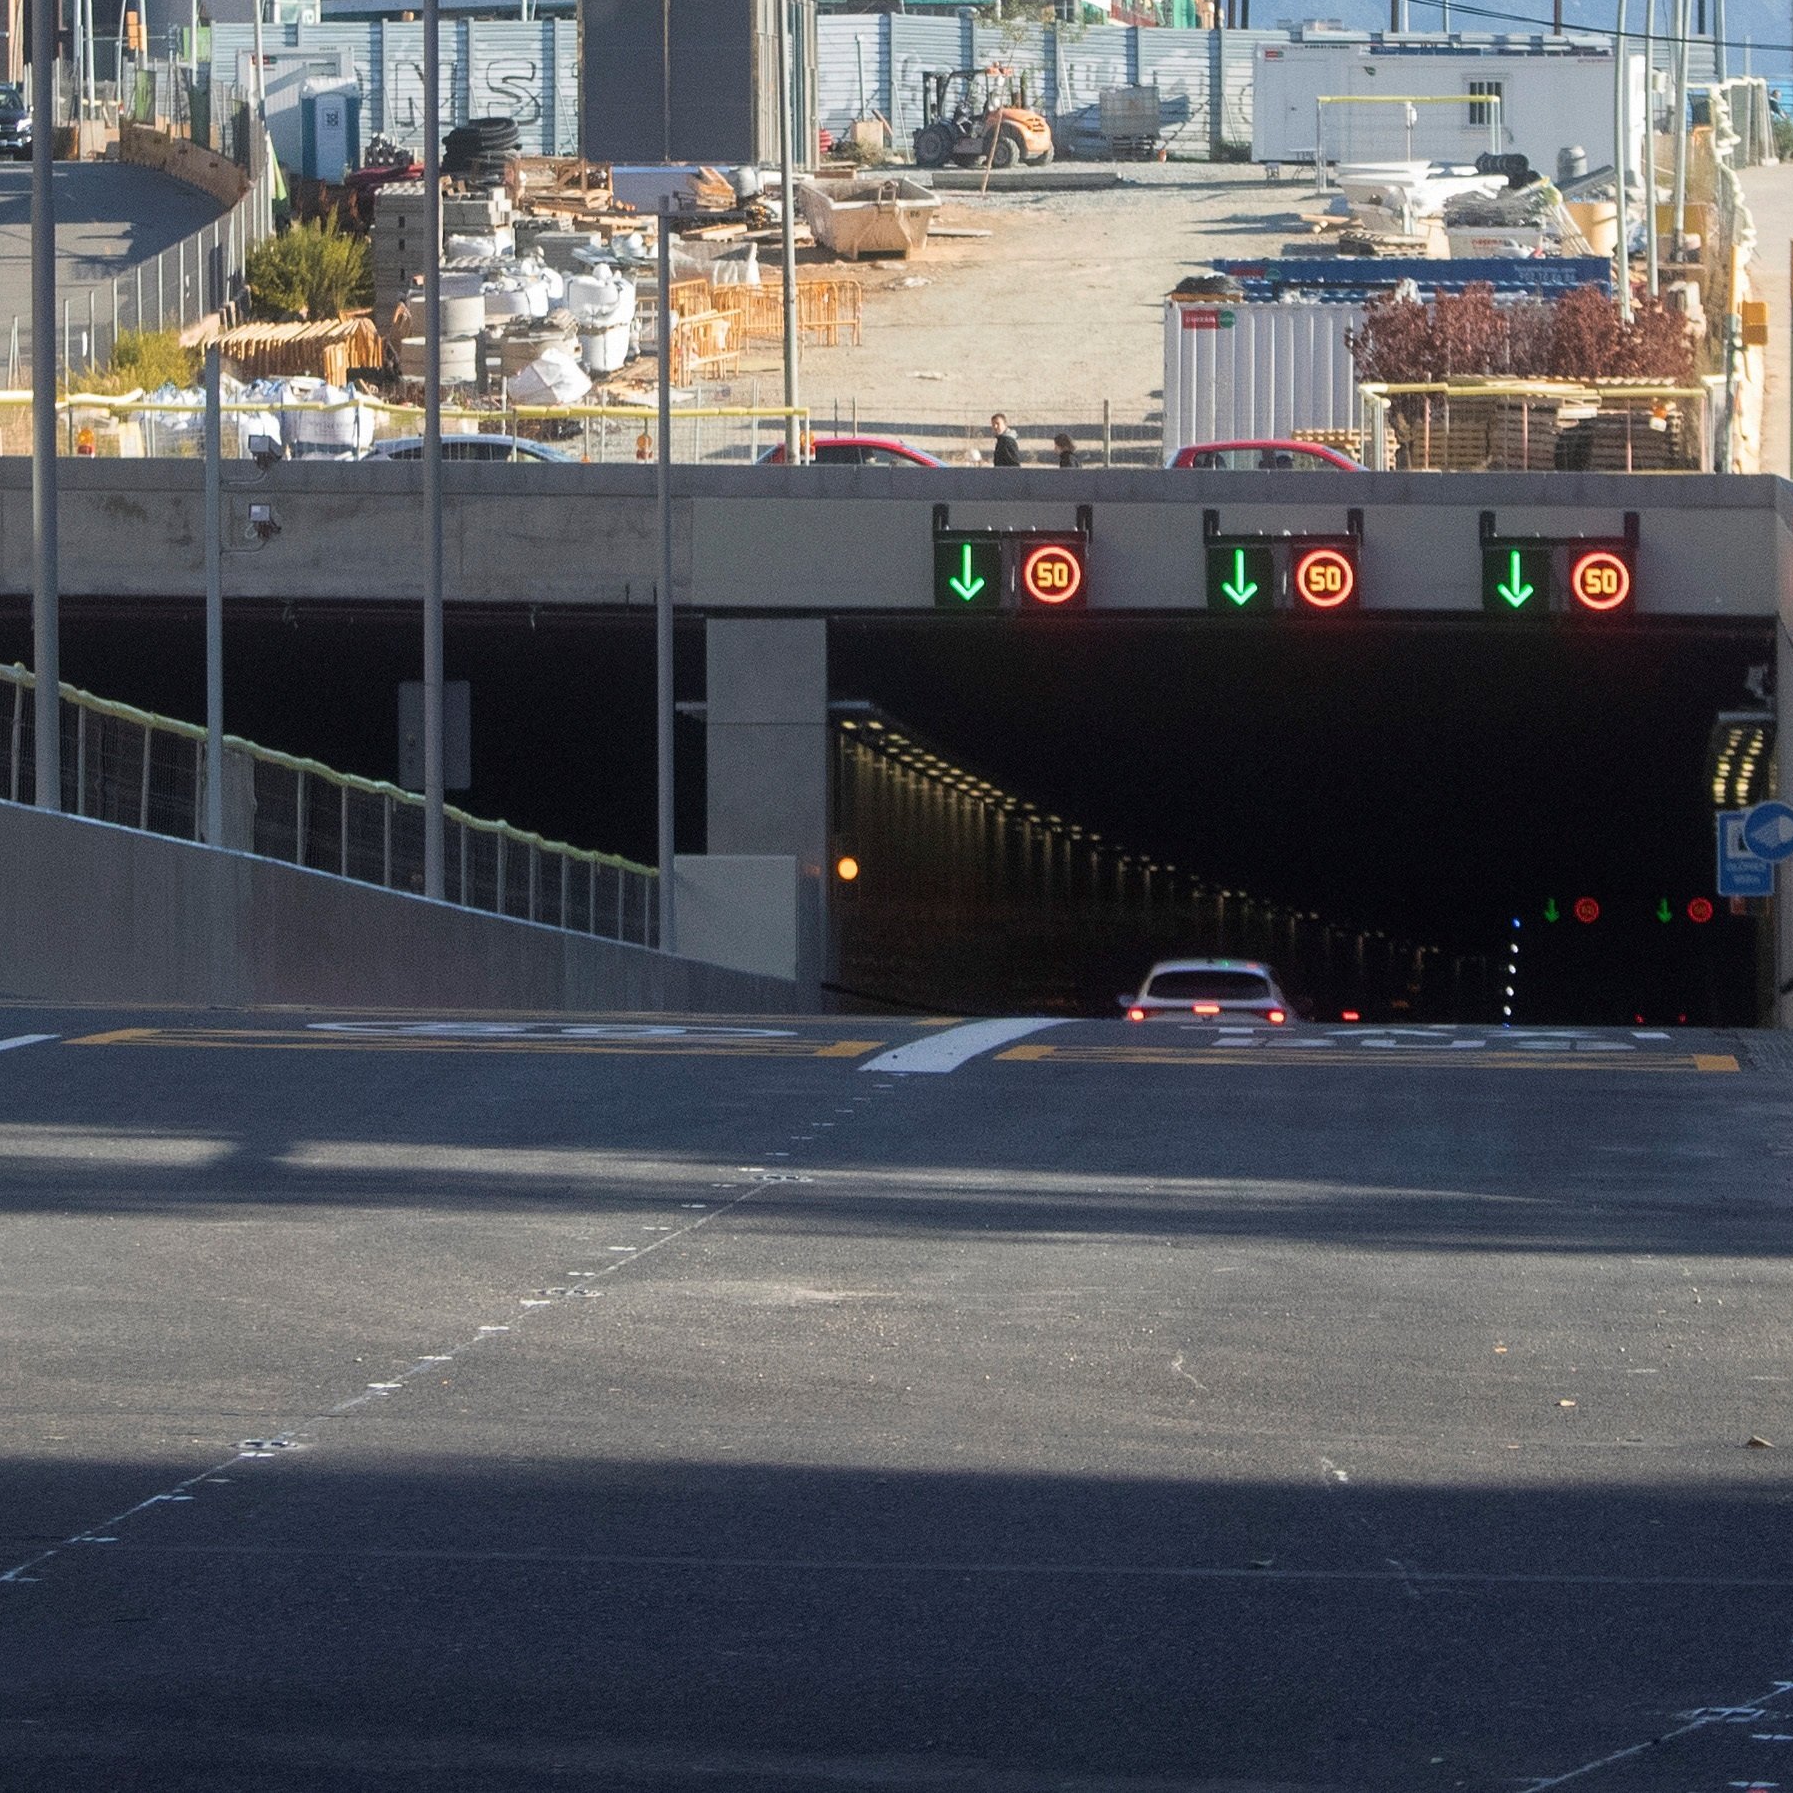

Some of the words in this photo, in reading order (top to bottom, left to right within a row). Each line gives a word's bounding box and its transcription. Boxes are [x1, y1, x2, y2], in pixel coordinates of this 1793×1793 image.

[1037, 562, 1069, 588] 50
[1310, 566, 1341, 593] 50
[1585, 568, 1618, 596] 50
